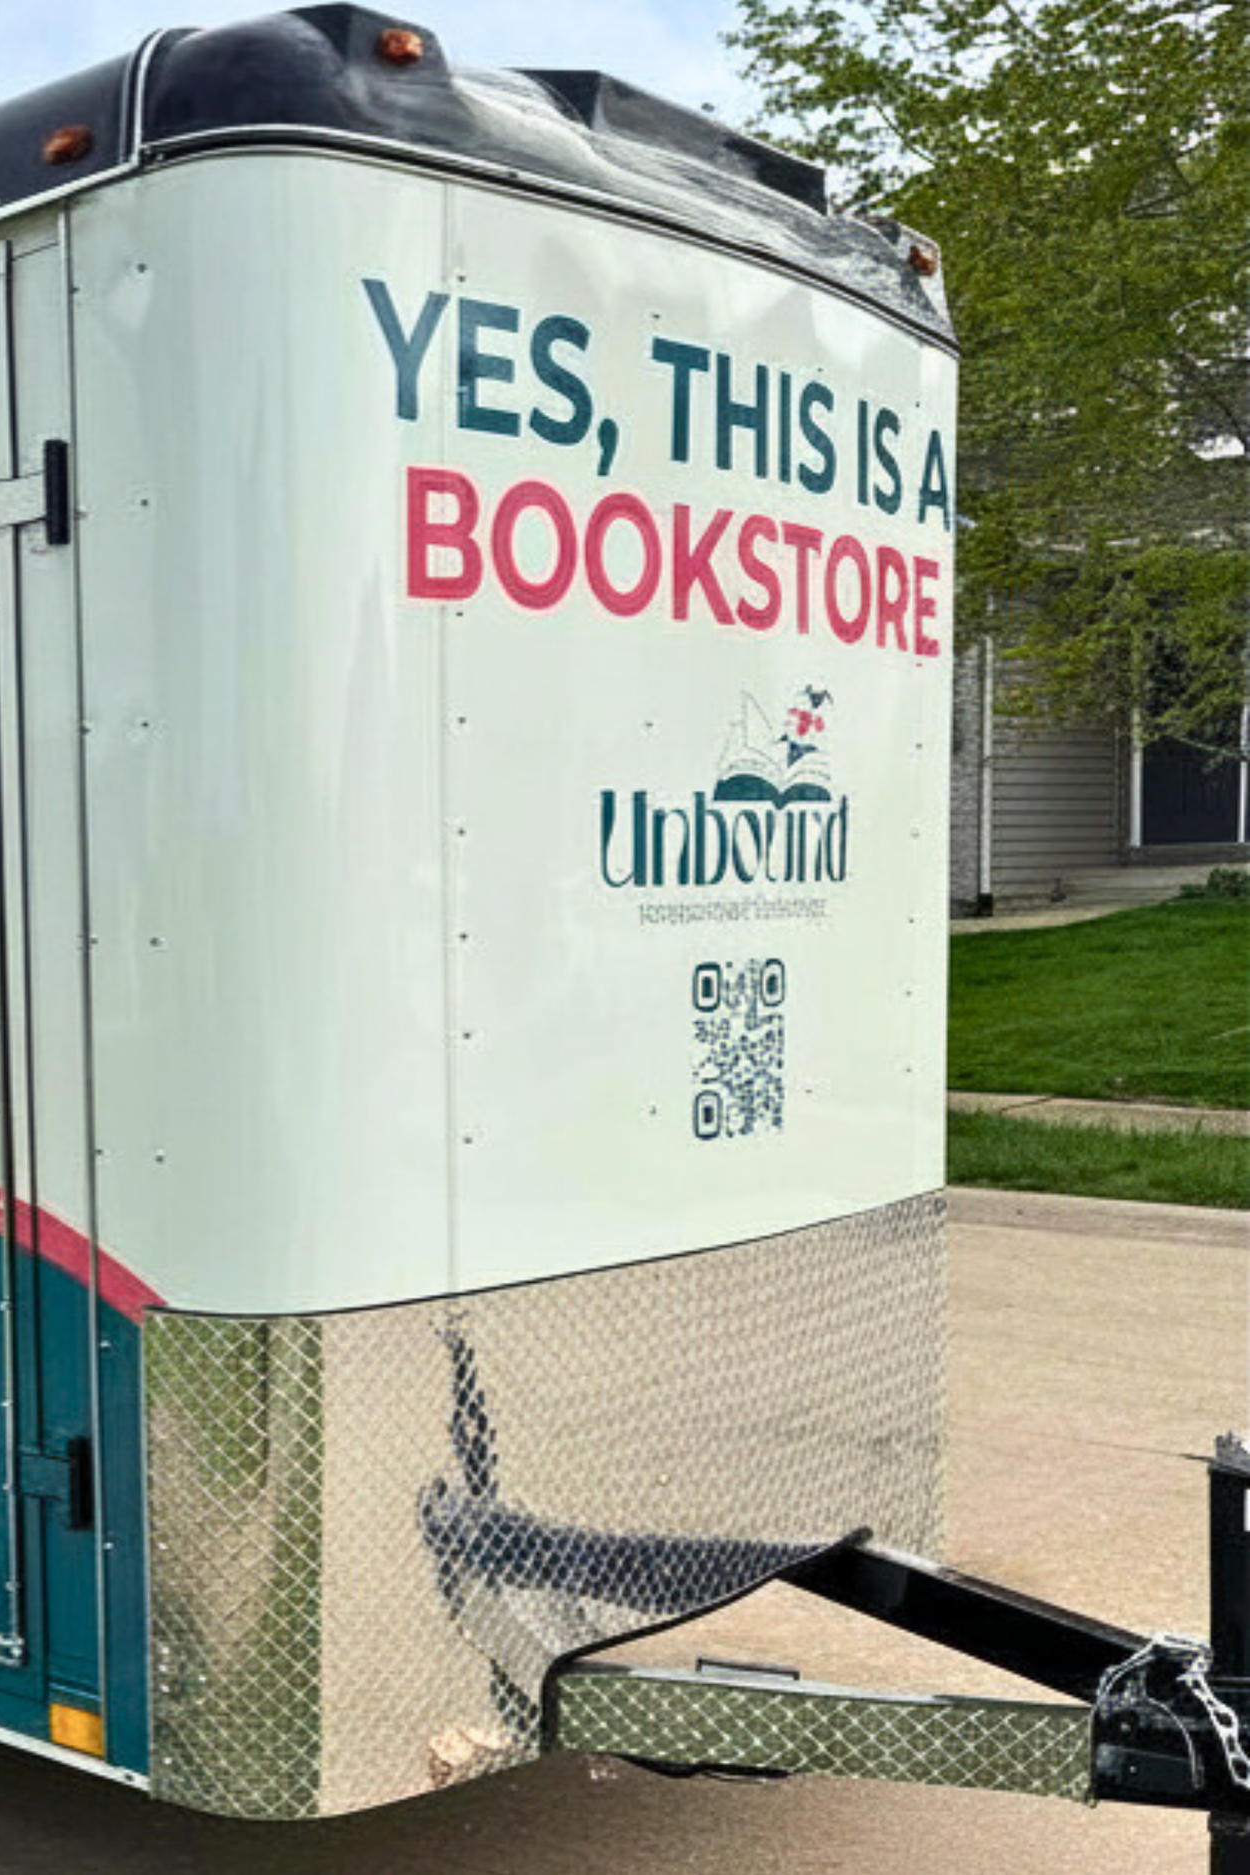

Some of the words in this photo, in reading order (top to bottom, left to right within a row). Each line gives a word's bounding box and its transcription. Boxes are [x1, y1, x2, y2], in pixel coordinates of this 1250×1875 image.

[361, 278, 619, 477] YES,
[652, 336, 837, 495] THIS
[857, 398, 903, 515] IS
[918, 429, 951, 532] A
[405, 465, 942, 657] BOOKSTORE
[600, 789, 849, 888] Unbound
